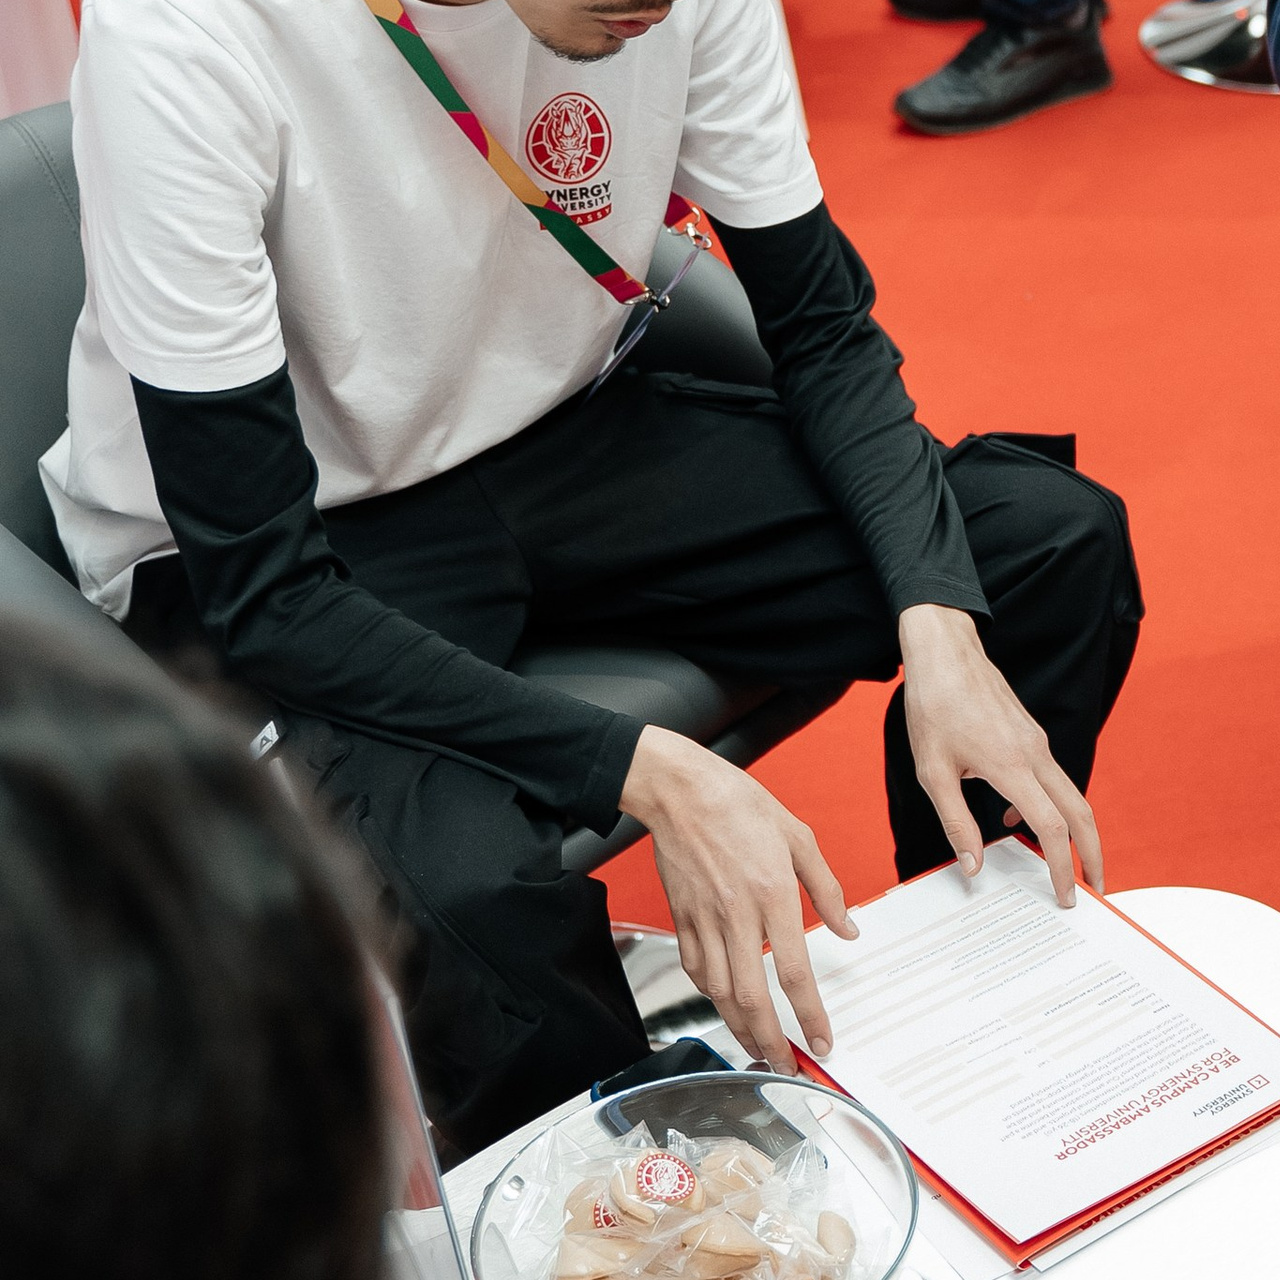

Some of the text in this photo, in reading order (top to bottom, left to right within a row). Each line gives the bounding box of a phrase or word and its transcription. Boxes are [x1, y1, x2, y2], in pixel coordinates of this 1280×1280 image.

[545, 180, 611, 202] YNERGY
[1052, 1053, 1241, 1162] BE A CAMPUS AMBASSADOR
[1057, 1046, 1232, 1147] FOR SYNERGY UNIVERSITY
[1189, 1082, 1249, 1118] UNIVERSITY
[1206, 1087, 1255, 1116] SYNERGY
